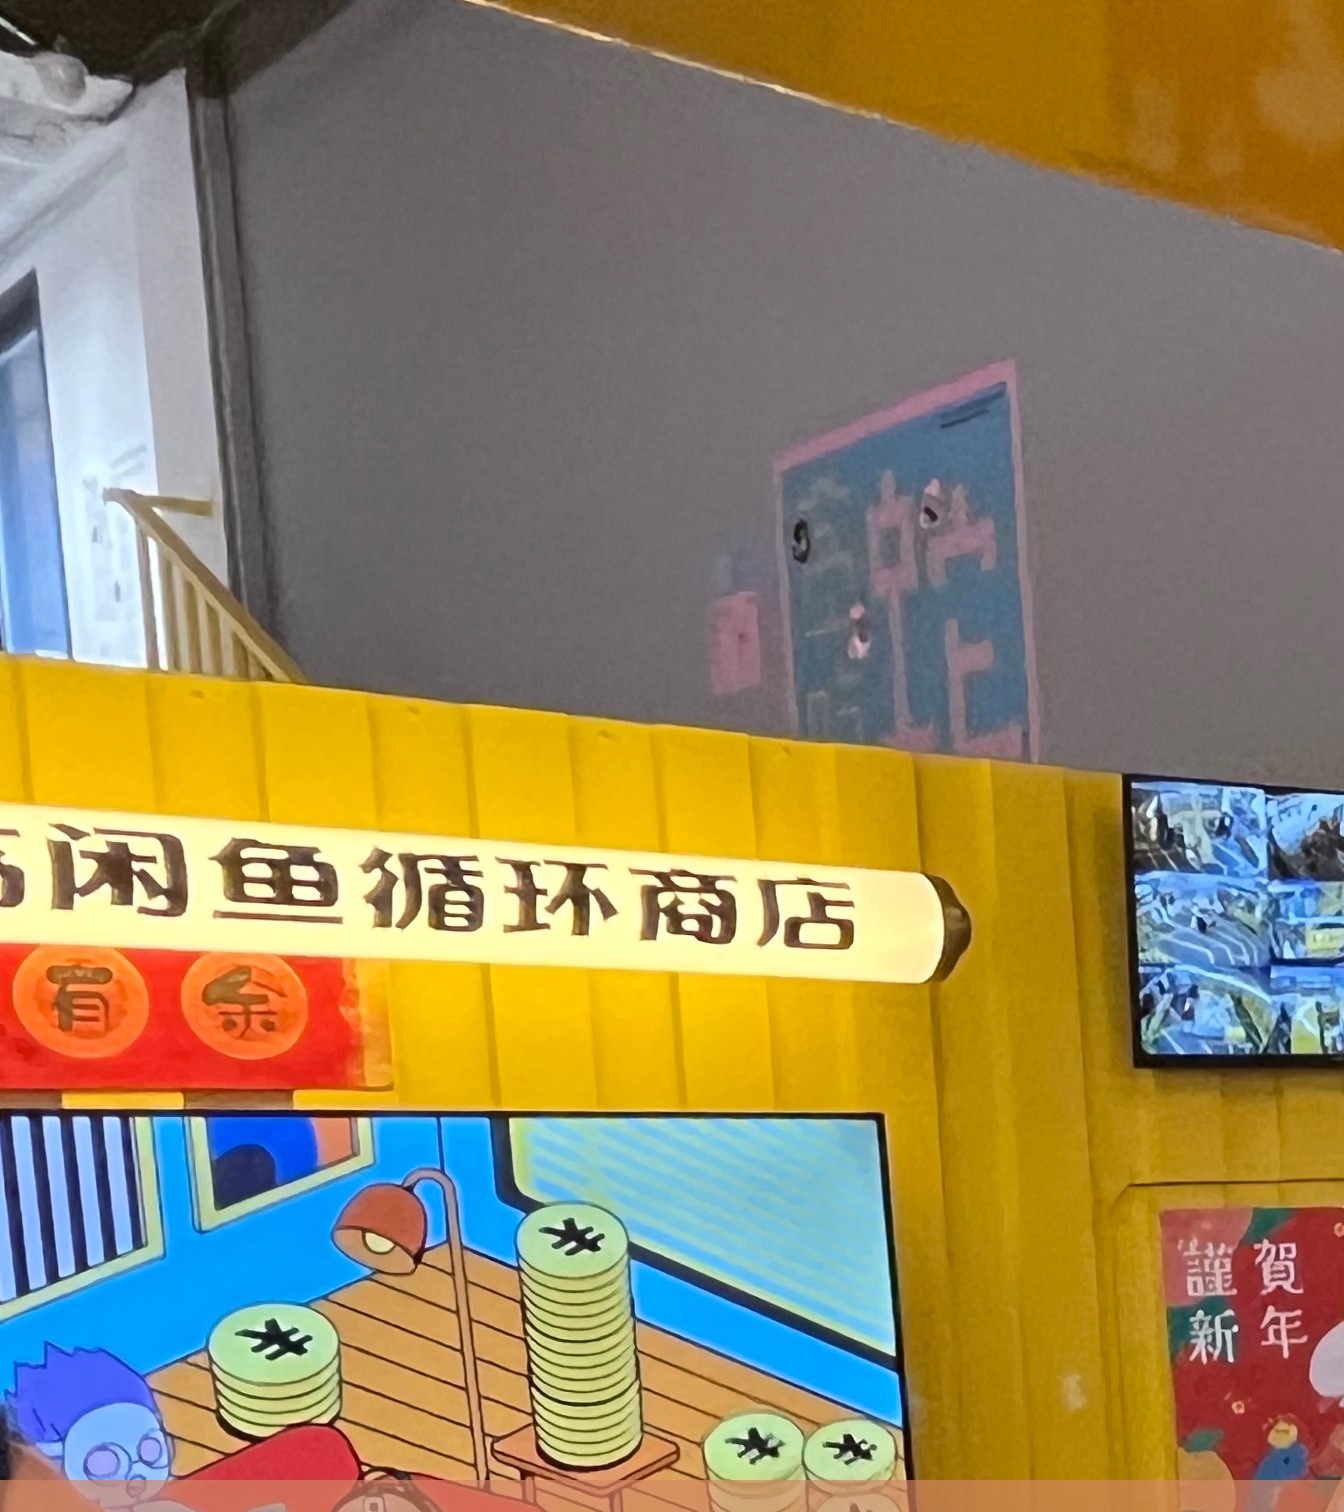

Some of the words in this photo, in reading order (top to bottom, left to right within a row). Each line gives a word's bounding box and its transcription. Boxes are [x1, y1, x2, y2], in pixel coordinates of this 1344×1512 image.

[0, 822, 857, 951] 闲鱼循环商店
[1177, 1237, 1304, 1296] 謹賀
[1188, 1304, 1309, 1366] 新年
